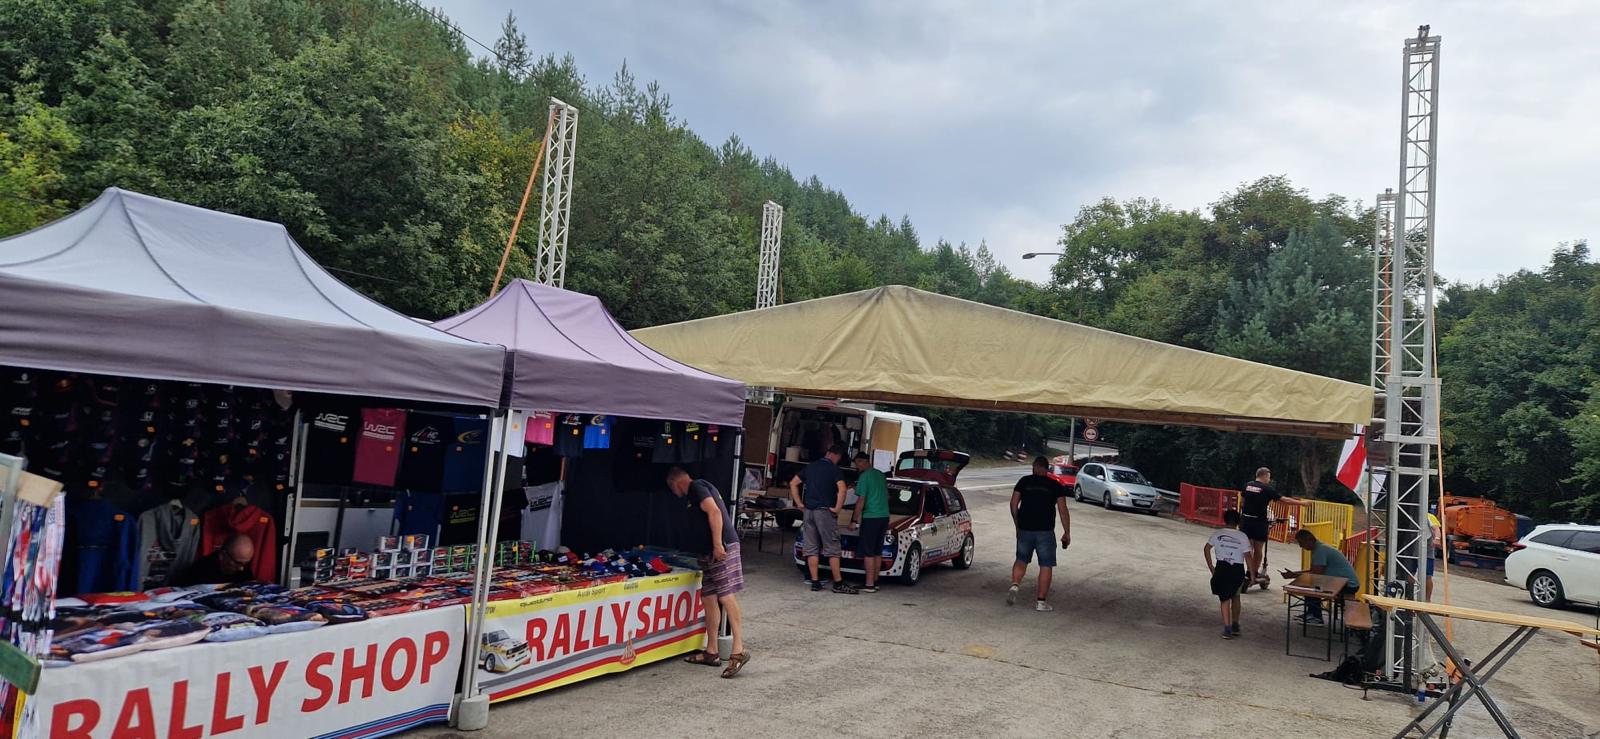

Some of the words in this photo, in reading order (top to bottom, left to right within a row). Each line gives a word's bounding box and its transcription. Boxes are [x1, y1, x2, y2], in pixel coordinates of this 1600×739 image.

[315, 413, 349, 426] WRC
[363, 421, 398, 435] WRC
[519, 596, 554, 608] quattro
[525, 601, 631, 665] RALLY
[49, 660, 290, 739] RALLY
[300, 629, 450, 713] SHOP
